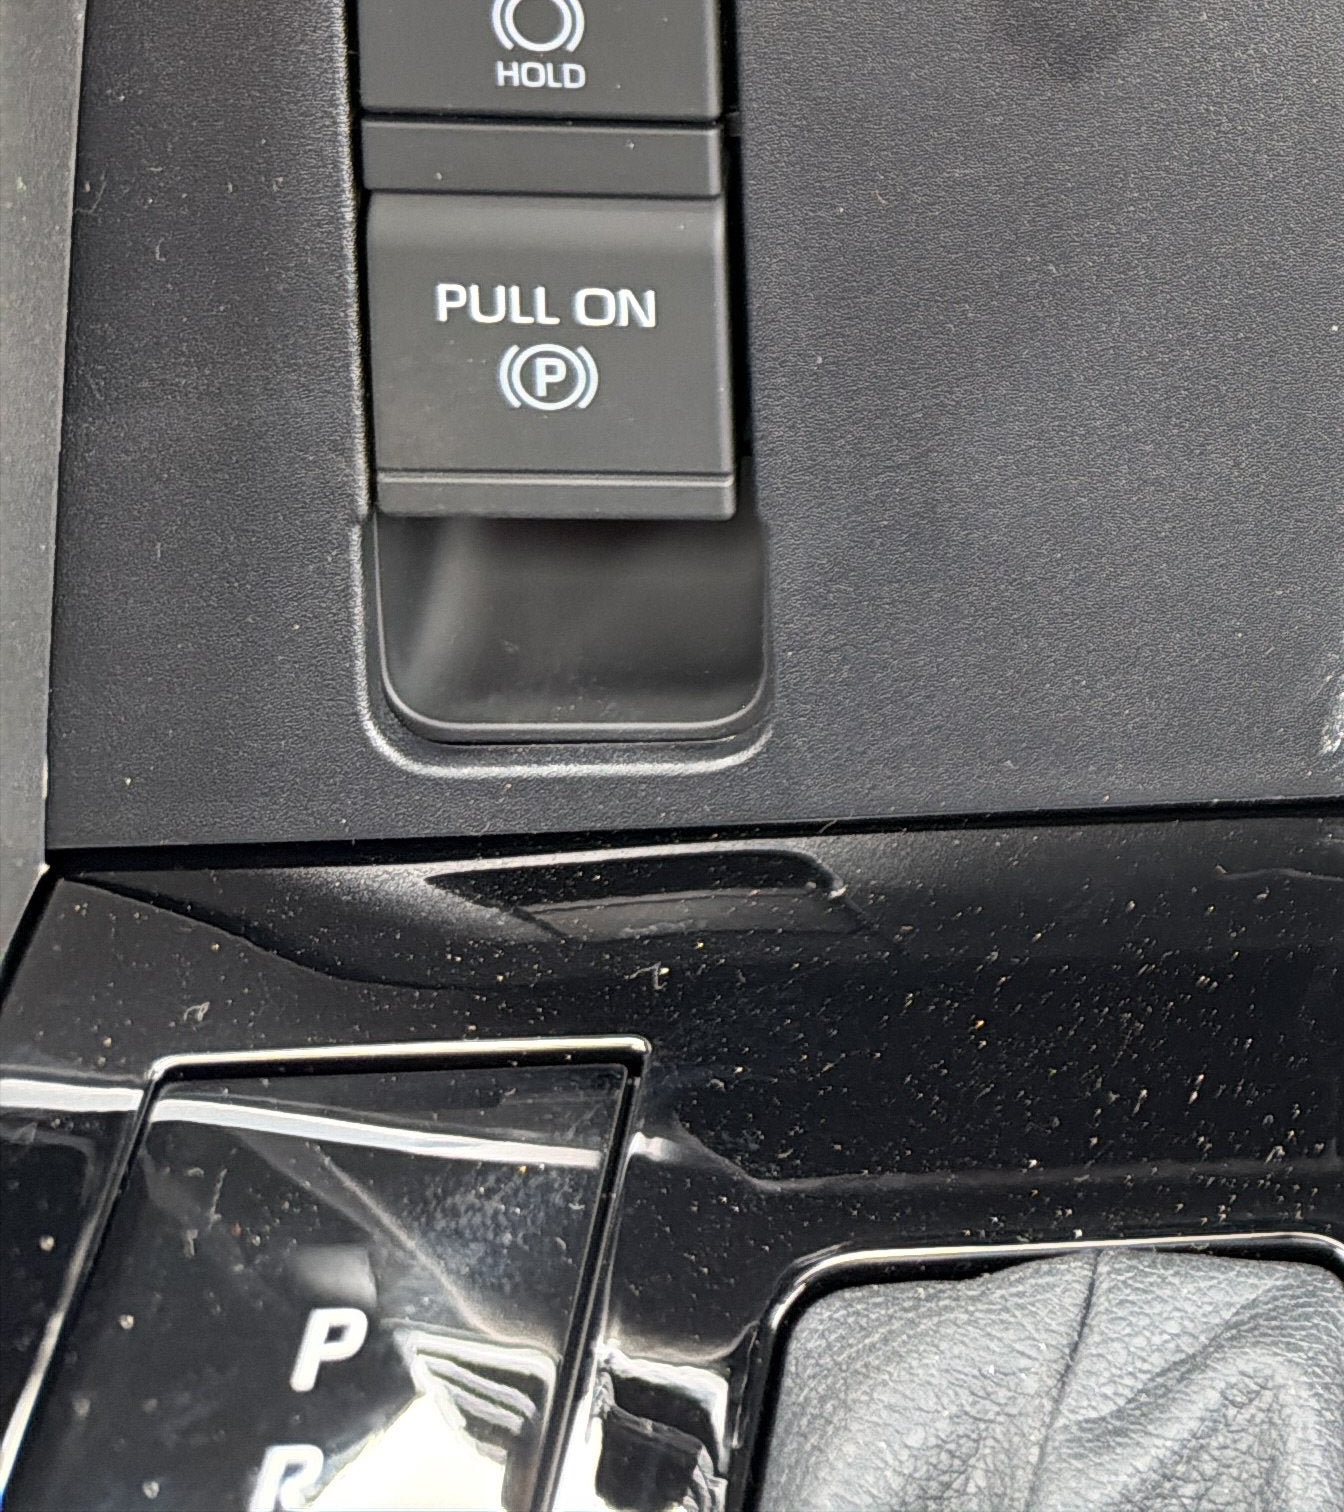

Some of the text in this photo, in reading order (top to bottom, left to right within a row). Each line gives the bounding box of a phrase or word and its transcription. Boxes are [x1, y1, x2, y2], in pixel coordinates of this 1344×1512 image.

[496, 61, 587, 89] HOLD
[434, 283, 658, 328] PULL ON
[534, 358, 566, 398] P
[289, 1306, 369, 1392] P
[247, 1443, 324, 1512] R
